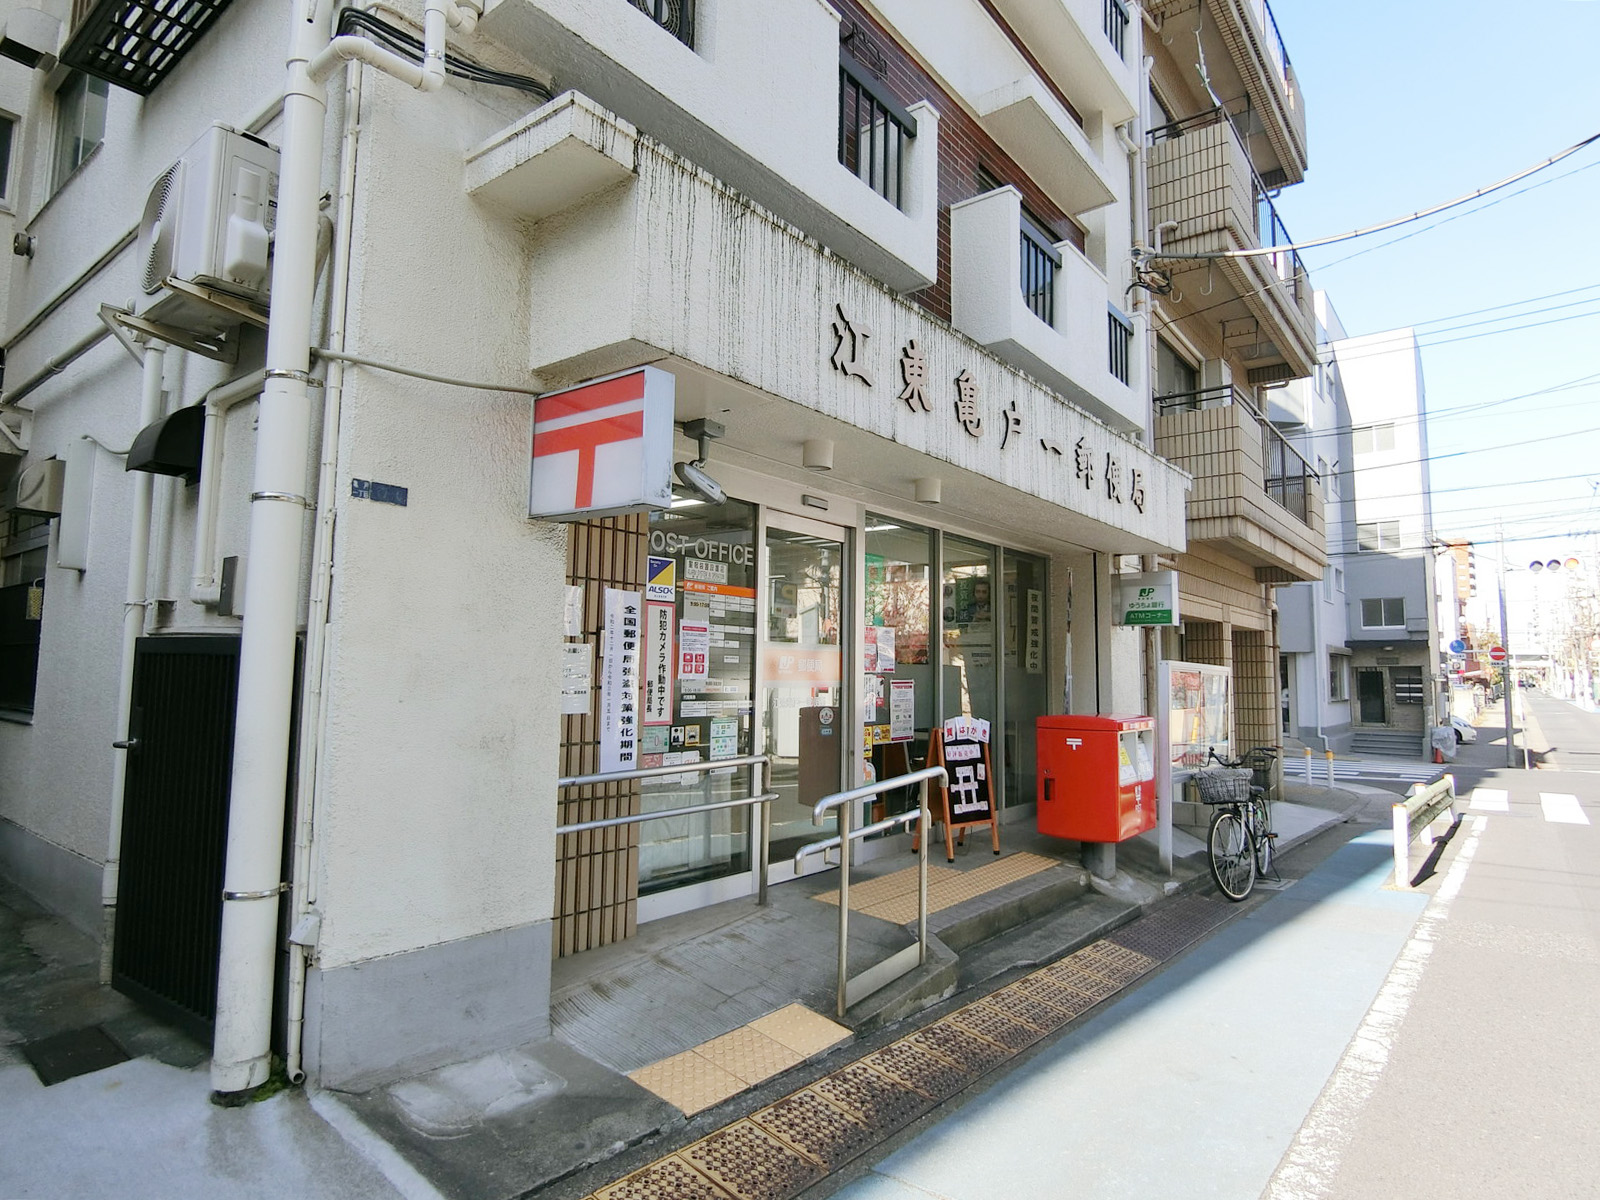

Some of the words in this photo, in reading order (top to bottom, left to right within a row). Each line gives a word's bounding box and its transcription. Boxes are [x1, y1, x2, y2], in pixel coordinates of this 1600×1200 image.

[831, 303, 1147, 514] 江東亀戸一郵便局
[647, 530, 689, 556] OST
[694, 537, 754, 566] OFFICE
[648, 585, 673, 595] ALSOK
[1128, 601, 1165, 609] ゆうちょ銀行
[656, 609, 668, 718] 防犯カメラ作動中です
[646, 680, 654, 713] 郵便局長
